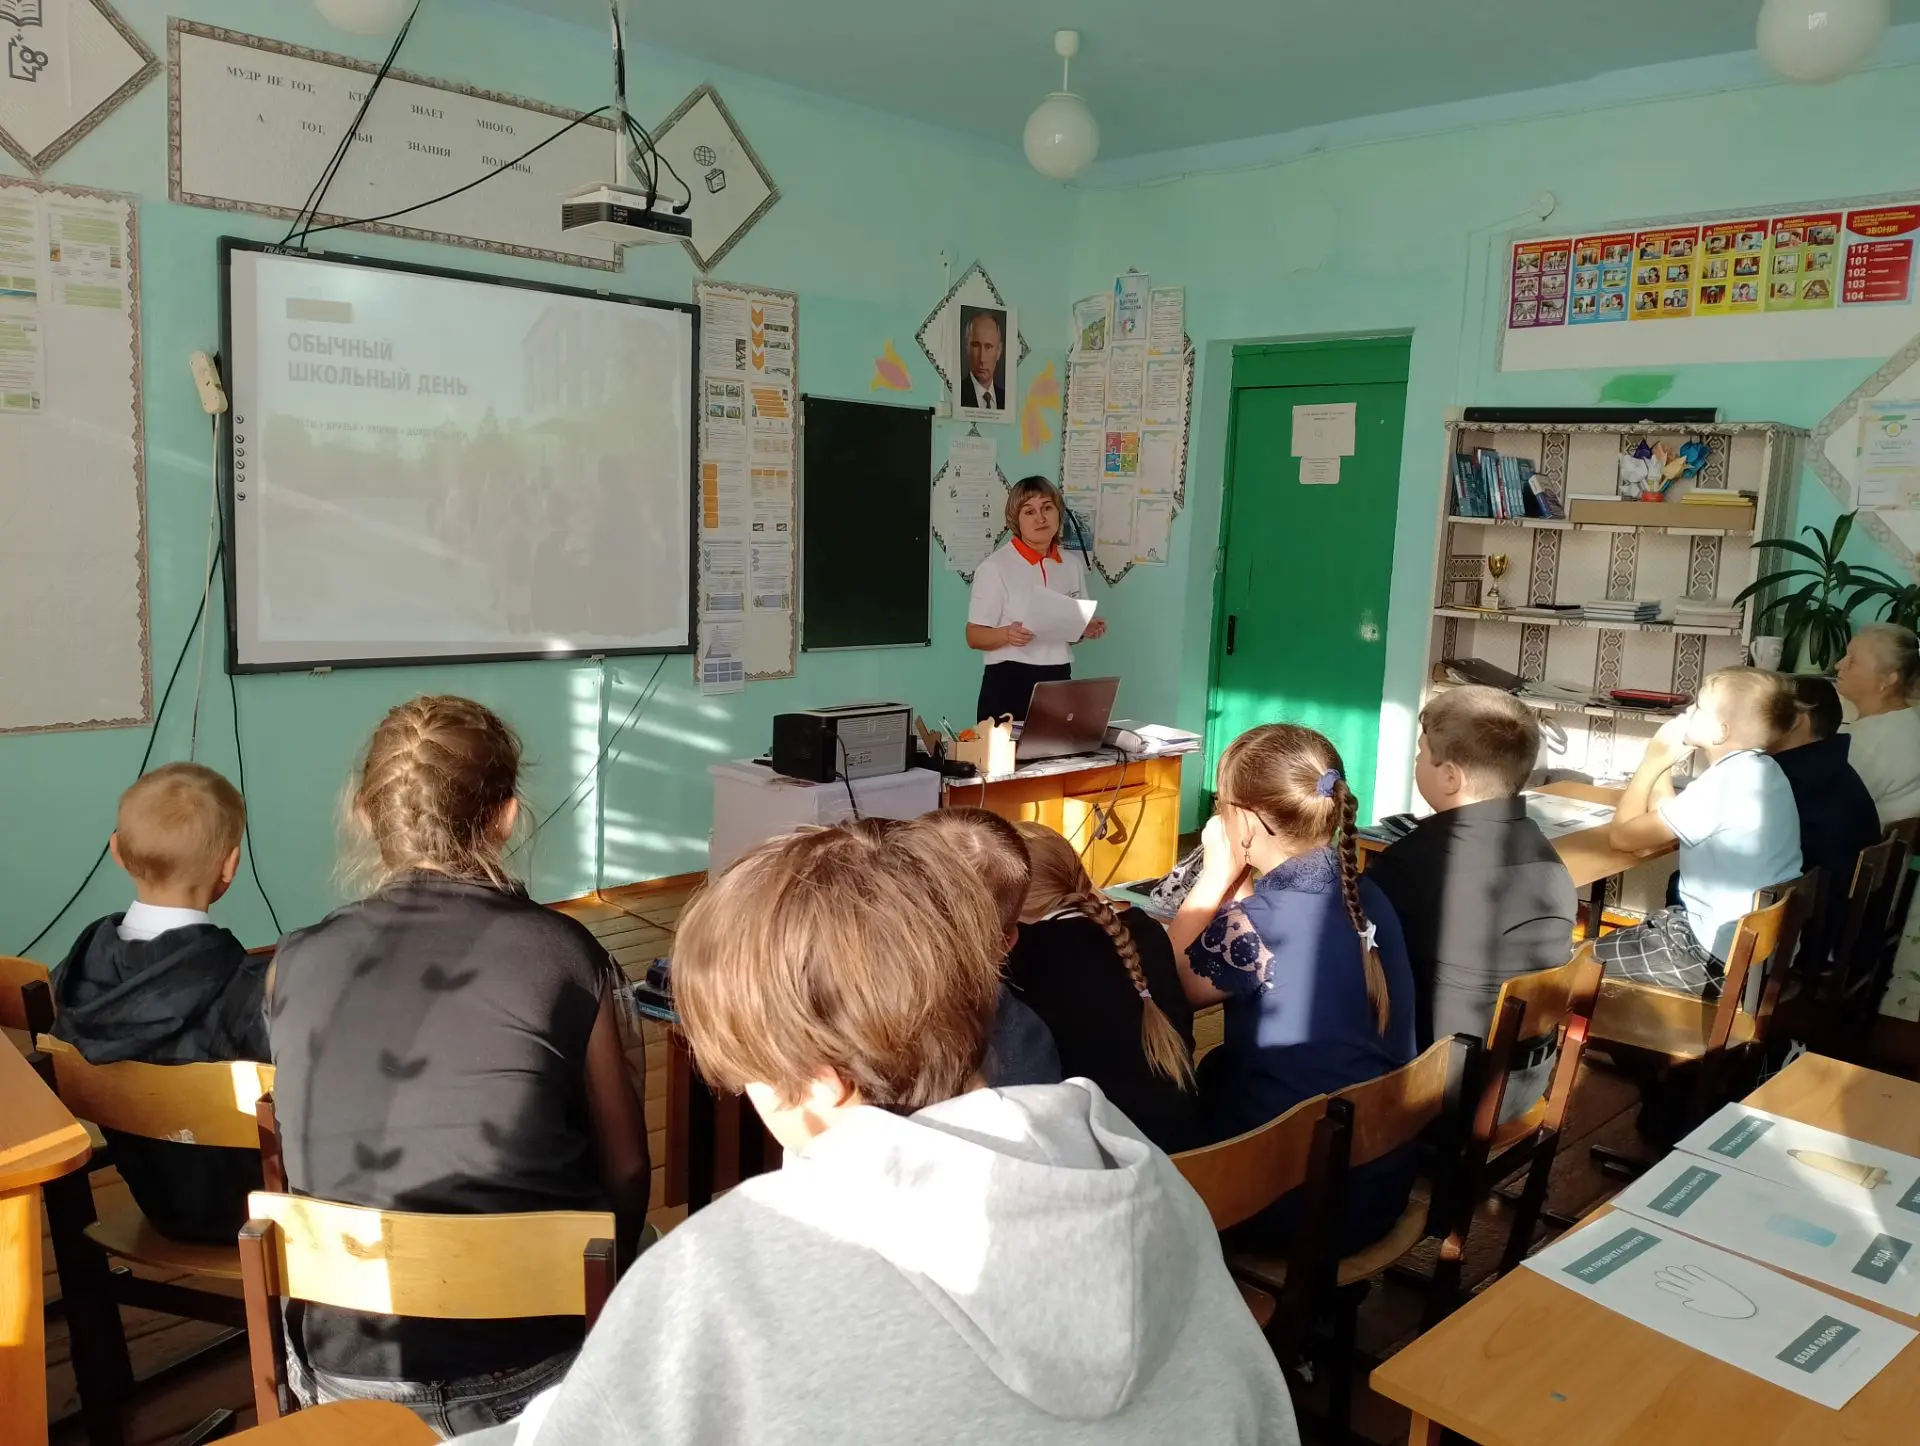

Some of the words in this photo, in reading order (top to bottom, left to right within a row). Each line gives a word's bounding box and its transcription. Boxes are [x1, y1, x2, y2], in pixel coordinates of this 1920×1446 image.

[227, 65, 261, 81] МУДР
[267, 74, 283, 86] НЕ
[290, 79, 316, 95] ТОТ,
[410, 104, 445, 120] ЗНАЕТ
[256, 112, 265, 124] А
[299, 120, 326, 136] ТОТ,
[407, 140, 451, 158] ЗНАНИЯ
[1851, 244, 1869, 254] 112
[1849, 256, 1867, 265] 101
[1847, 268, 1866, 277] 102
[1847, 280, 1865, 289] 103
[1845, 291, 1864, 300] 104
[287, 332, 393, 361] ОБЫЧНЫЙ
[288, 361, 411, 392] ШКОЛЬНЫЙ
[417, 373, 468, 396] ДЕНЬ
[1871, 1249, 1892, 1268] ВОДА
[1579, 1266, 1596, 1276] ТРИ
[1793, 1344, 1820, 1364] БЕЛАЯ
[1814, 1325, 1843, 1347] ЛАДОНЬ
